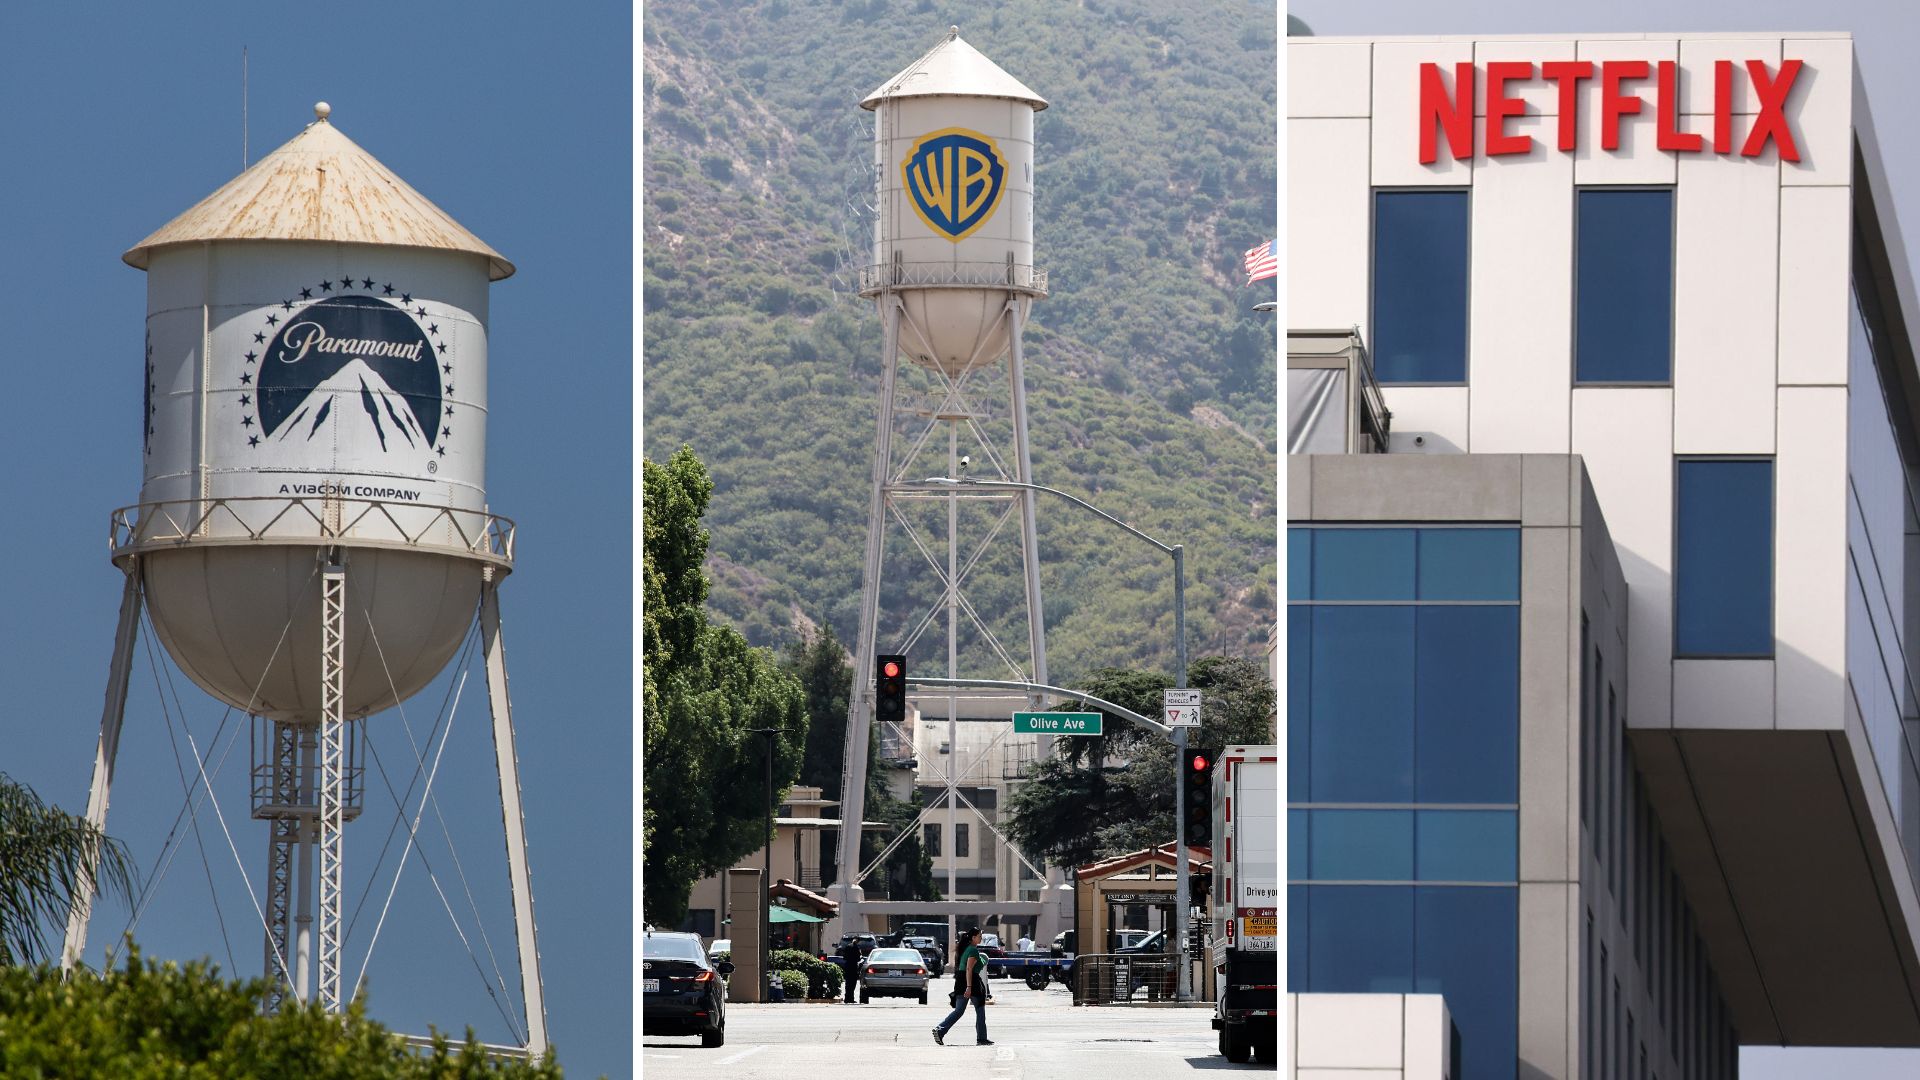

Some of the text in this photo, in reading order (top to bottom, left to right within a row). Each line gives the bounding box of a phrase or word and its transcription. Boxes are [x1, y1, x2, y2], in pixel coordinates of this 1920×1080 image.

[1420, 59, 1803, 164] NETFLIX
[913, 146, 993, 225] WB
[279, 321, 423, 364] Paramount
[279, 484, 289, 494] A
[354, 486, 421, 501] COMPANY
[1030, 717, 1086, 729] Olive Ave
[1246, 886, 1266, 897] Drive
